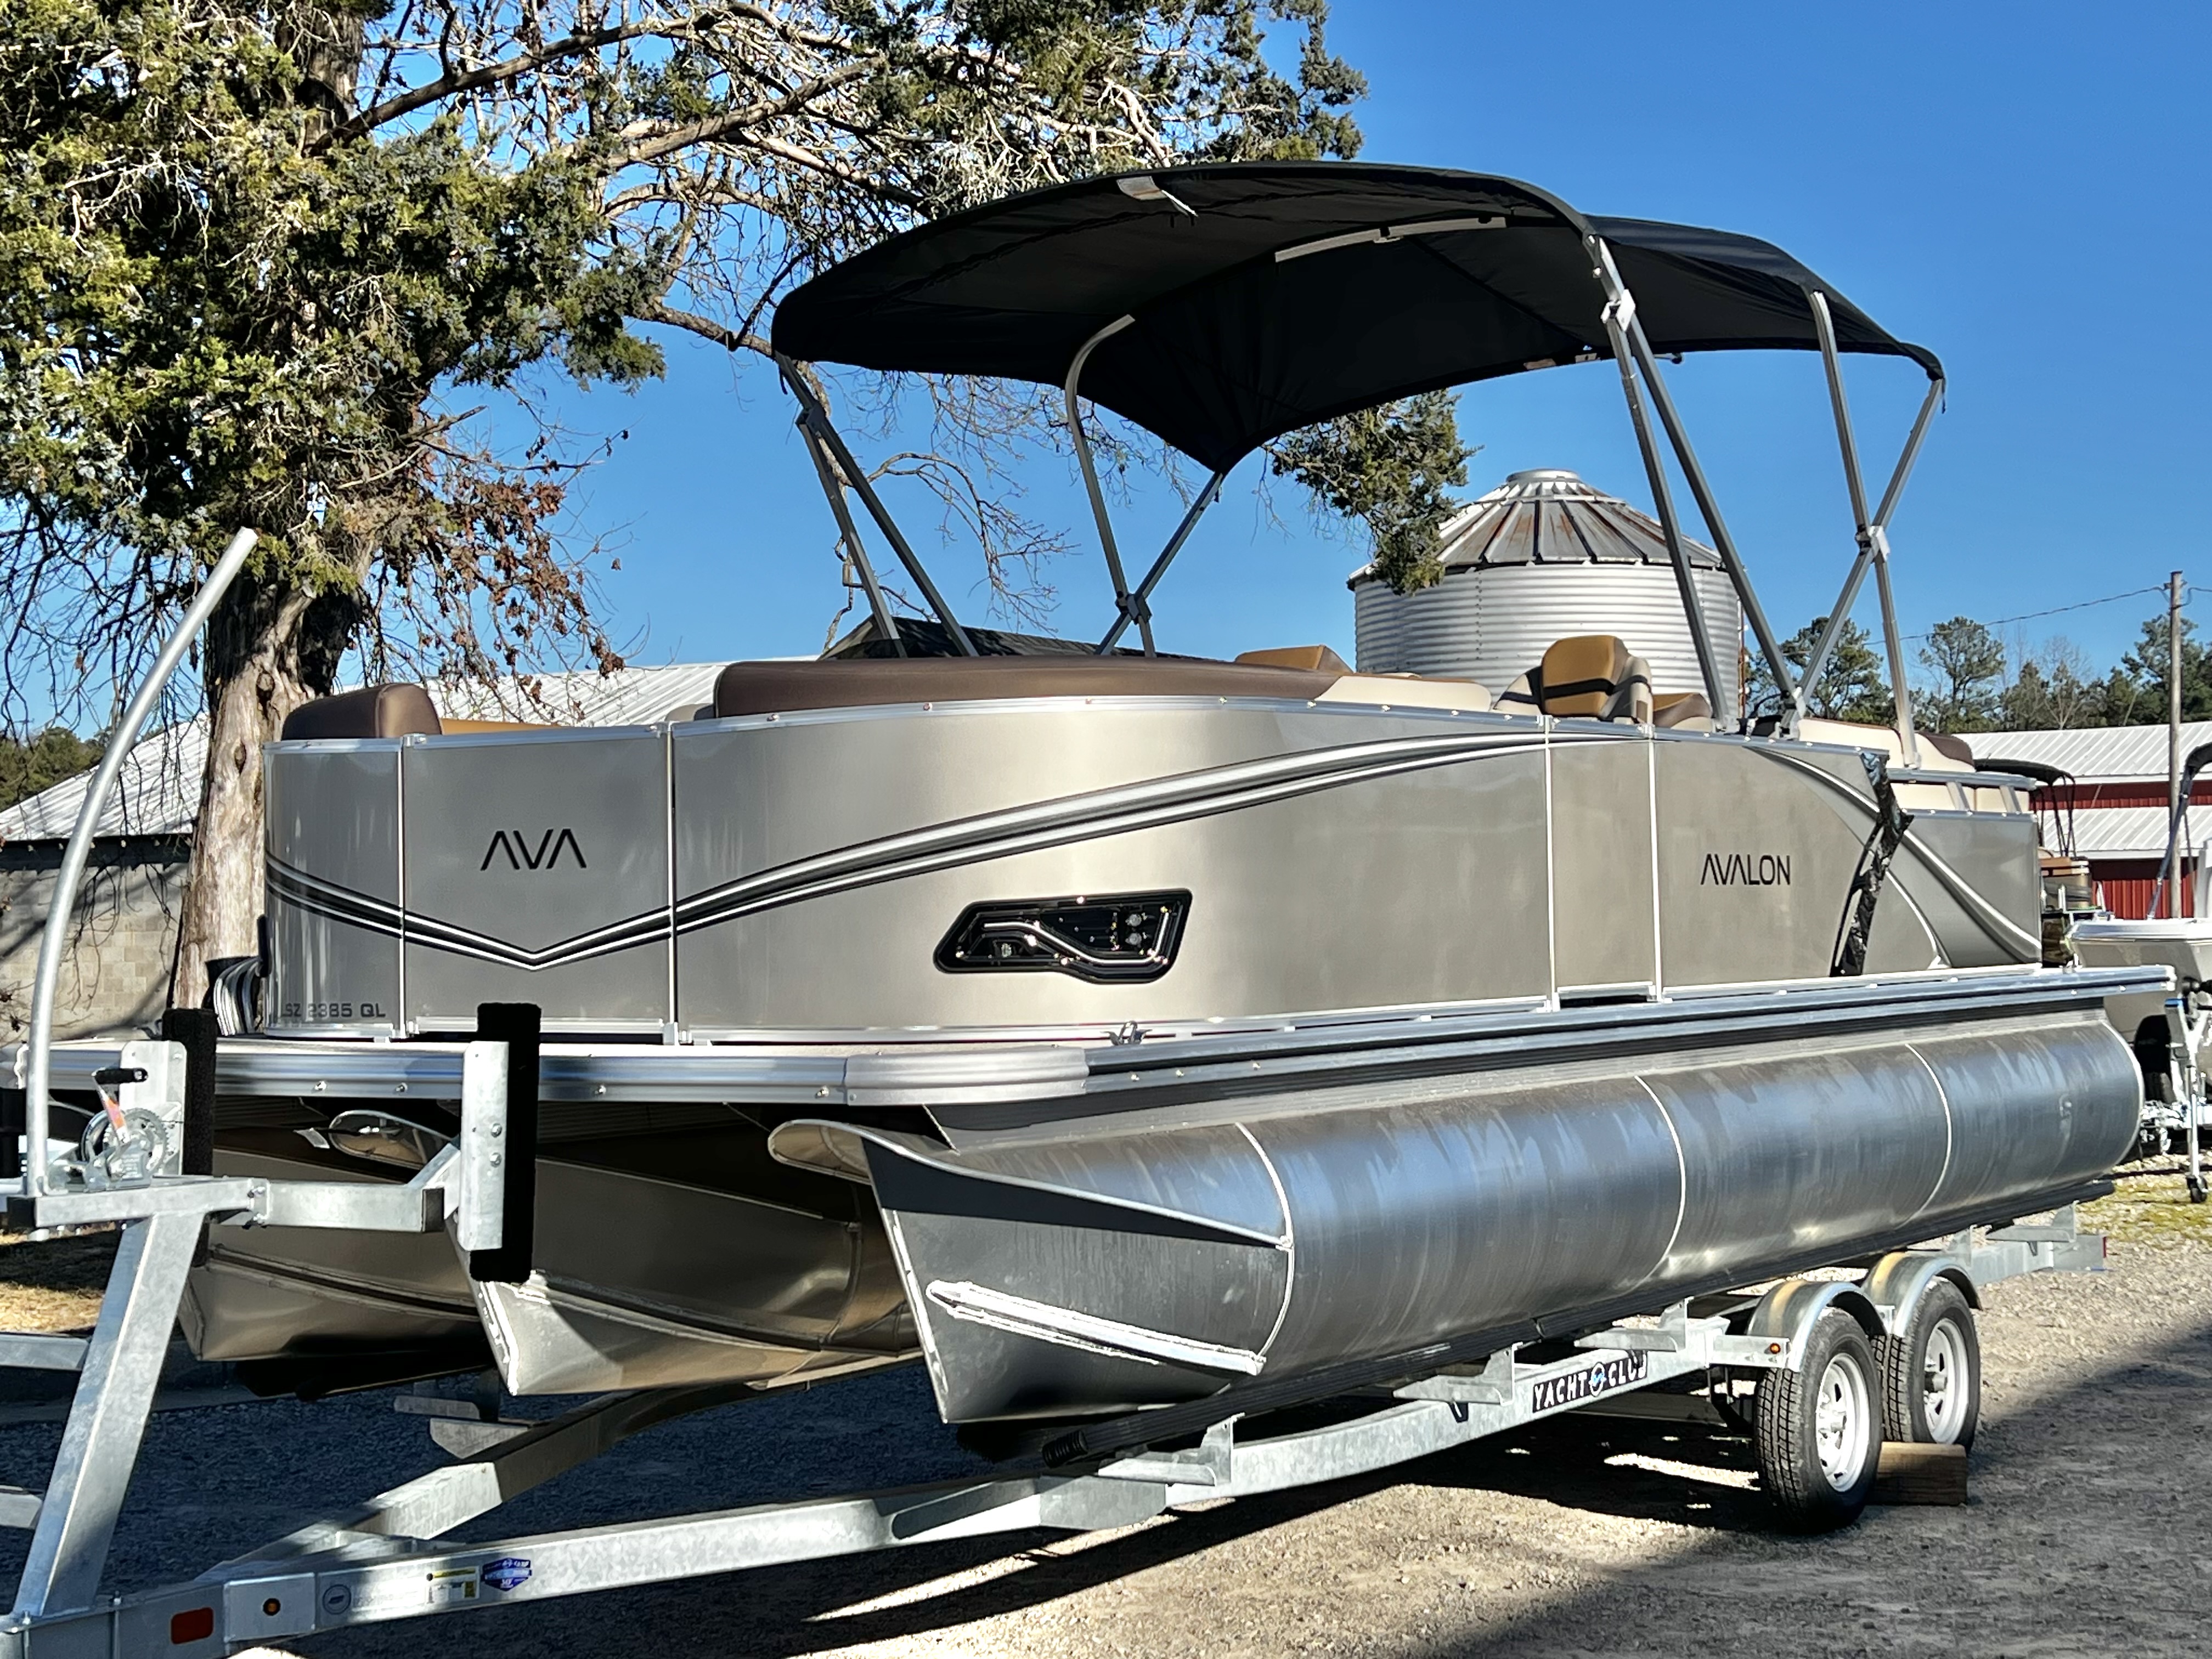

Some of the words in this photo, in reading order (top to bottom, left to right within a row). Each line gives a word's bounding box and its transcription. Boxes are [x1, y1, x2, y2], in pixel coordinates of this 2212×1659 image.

[481, 828, 586, 871] AVA
[1700, 853, 1791, 885] AVALON
[308, 1003, 353, 1018] 2385
[360, 1003, 386, 1018] QL
[1533, 1371, 1588, 1410] YACHT
